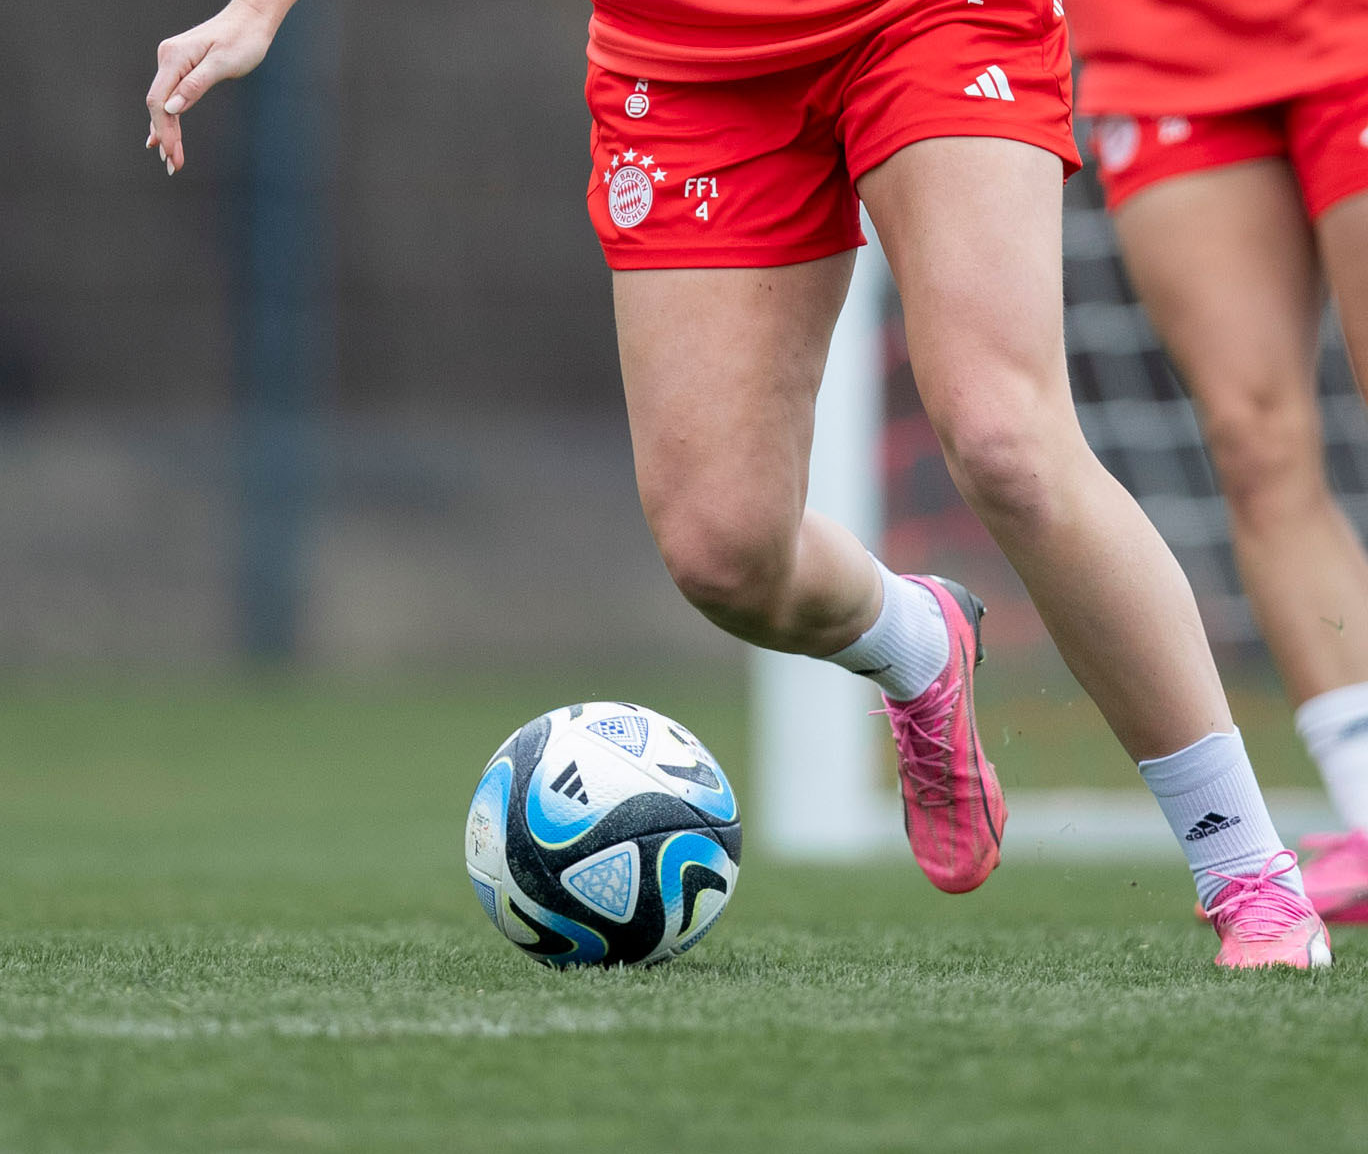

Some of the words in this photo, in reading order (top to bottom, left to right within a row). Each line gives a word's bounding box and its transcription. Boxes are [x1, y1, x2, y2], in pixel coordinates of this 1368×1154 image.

[620, 171, 648, 192] BAYERN
[684, 177, 719, 198] FF1
[695, 201, 709, 222] 4
[1185, 815, 1241, 841] adidas
